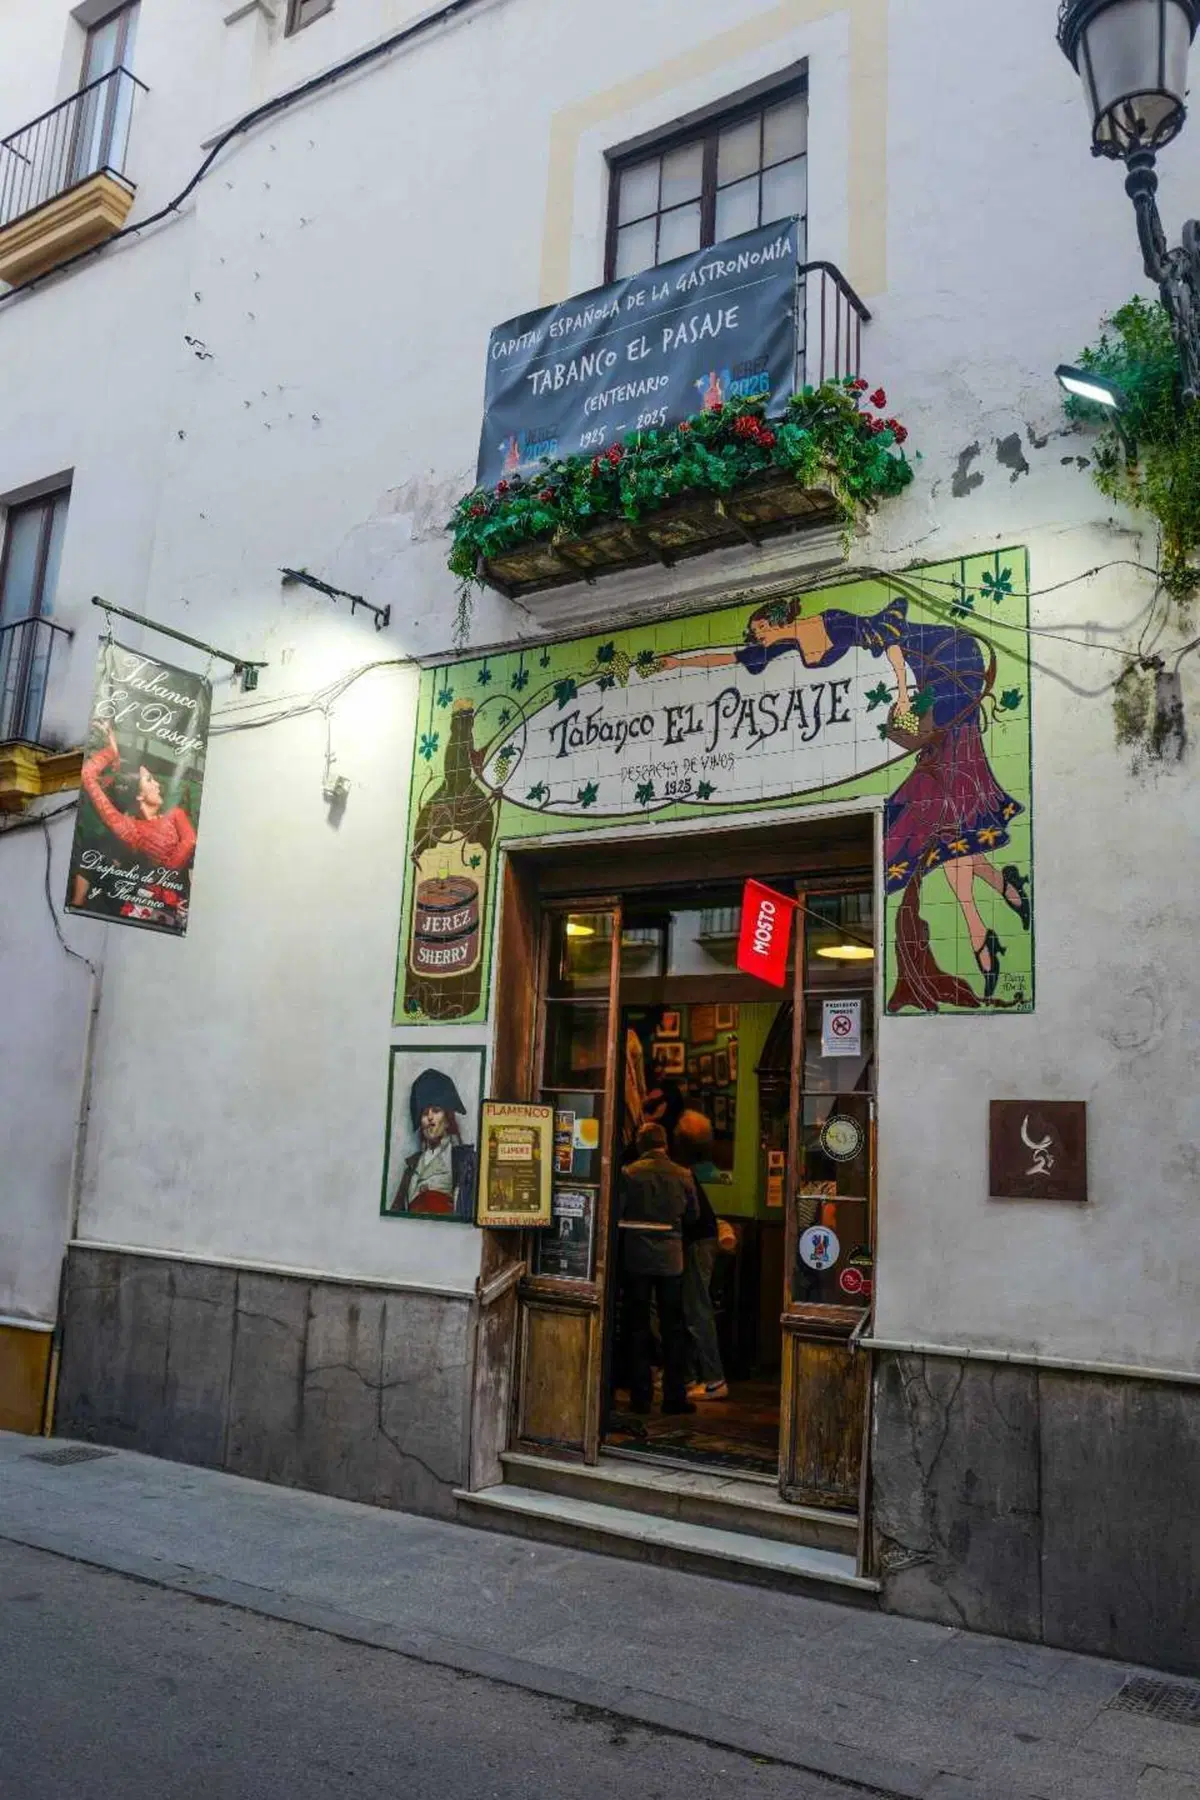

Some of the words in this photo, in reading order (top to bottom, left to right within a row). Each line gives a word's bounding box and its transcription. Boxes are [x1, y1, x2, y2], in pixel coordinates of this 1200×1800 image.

[491, 329, 542, 360] CAPITAL
[549, 301, 620, 338] ESPAÑOLA
[626, 290, 646, 311] DE
[651, 282, 670, 301] LA
[676, 236, 792, 293] GASTRONOMÍA
[527, 347, 618, 396] TABANCO
[626, 335, 653, 361] EL
[662, 305, 740, 353] PASAJE
[584, 375, 670, 416] CENTENARIO
[579, 425, 608, 449] 1925
[636, 405, 669, 430] 2025
[111, 653, 197, 710] Tabanco
[96, 690, 138, 723] El
[136, 703, 206, 755] Pasaje
[549, 706, 654, 758] Tabanco
[663, 705, 703, 746] EL
[705, 678, 852, 753] PASAJE
[664, 778, 692, 795] 1925
[683, 757, 698, 777] DE
[80, 849, 140, 882] Despacho
[140, 866, 154, 886] de
[154, 867, 183, 891] Vinos
[89, 887, 101, 900] y
[421, 909, 471, 932] JEREZ
[752, 900, 776, 956] MOSTO
[417, 942, 469, 965] SHERRY
[486, 1104, 550, 1118] FLAMENCO
